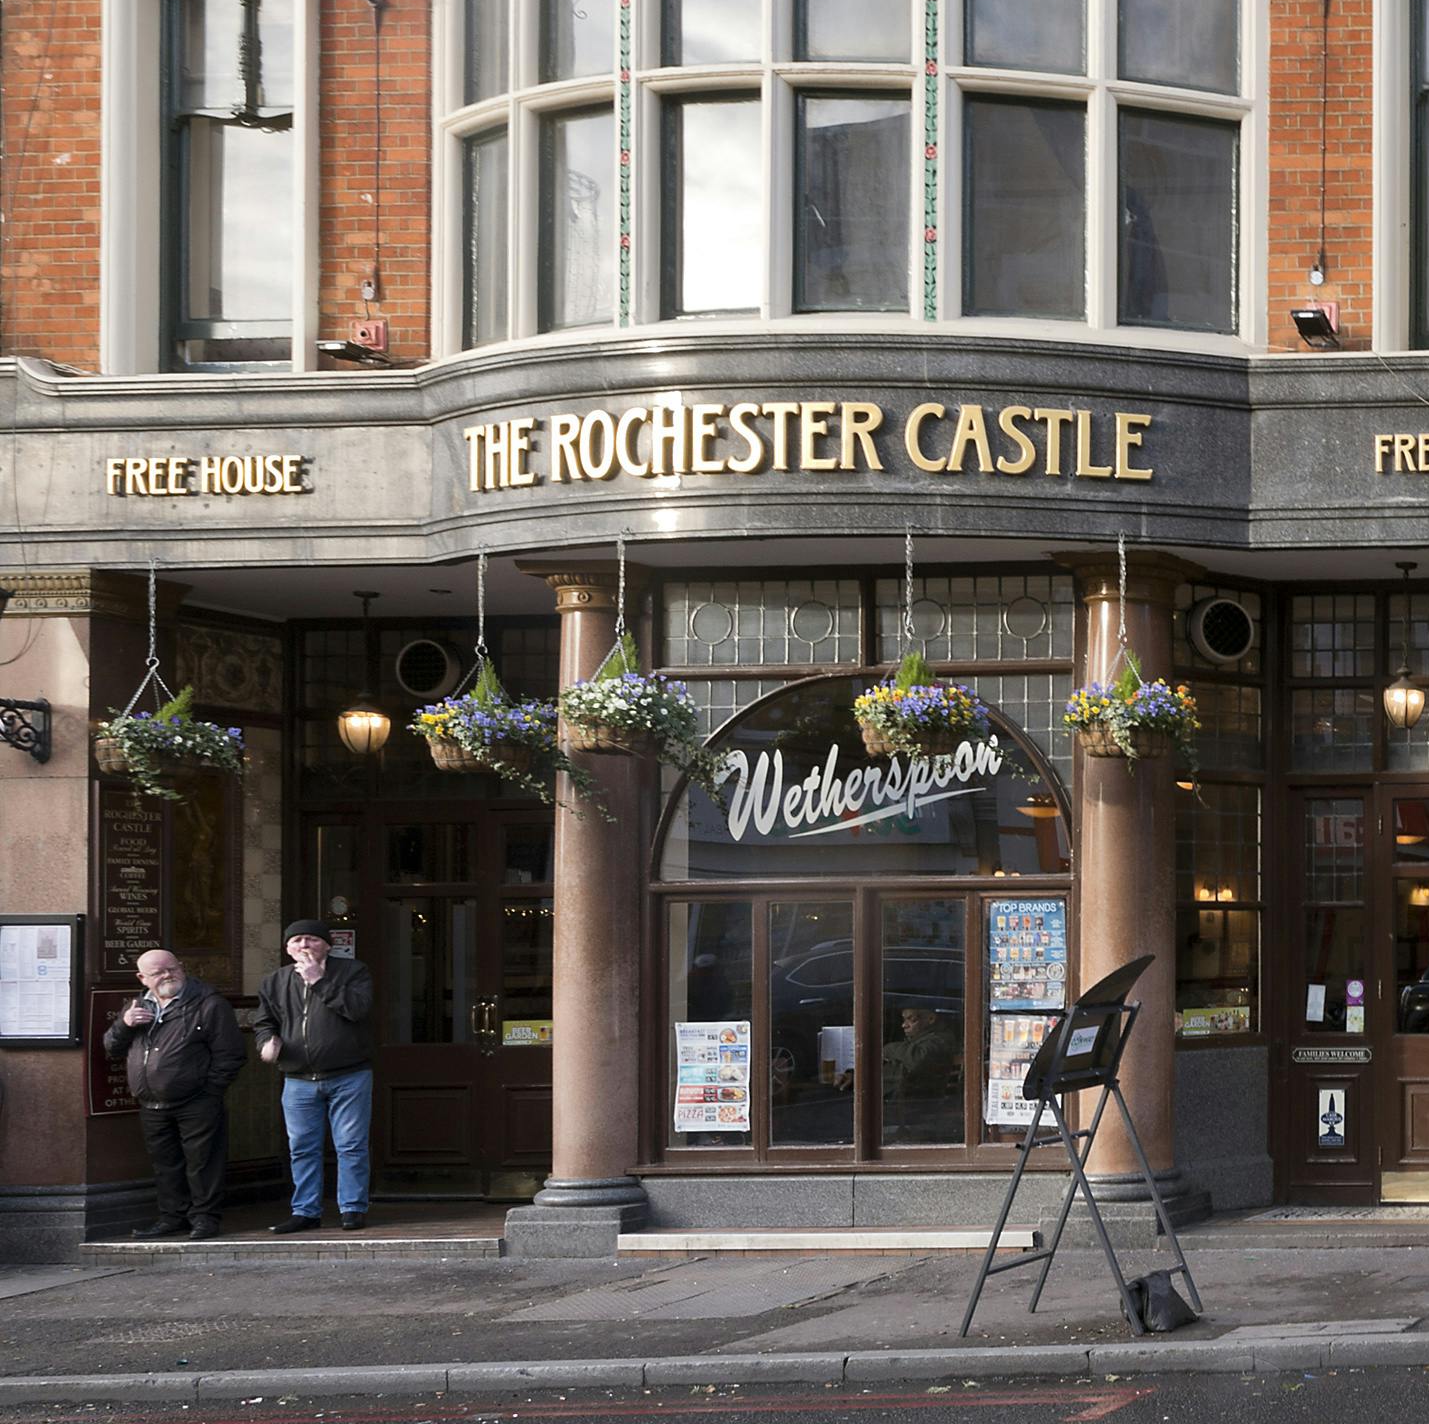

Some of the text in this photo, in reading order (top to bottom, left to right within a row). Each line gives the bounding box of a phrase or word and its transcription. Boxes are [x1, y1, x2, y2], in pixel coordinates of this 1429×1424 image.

[464, 401, 1154, 492] THE ROCHESTER CASTLE
[106, 454, 302, 495] FREE HOUSE
[712, 733, 1003, 842] Wetherspoon
[113, 823, 153, 833] CASTLE
[119, 838, 147, 847] FOOD
[119, 893, 148, 901] WINES
[999, 902, 1057, 913] TOP BRANDS
[116, 926, 150, 934] SPIRITS
[104, 940, 160, 949] BEER GARDEN
[511, 1026, 532, 1034] BEER
[504, 1032, 539, 1040] GARDEN
[1298, 1050, 1366, 1058] FAMILIES WELCOME
[679, 1109, 704, 1120] PIZZA
